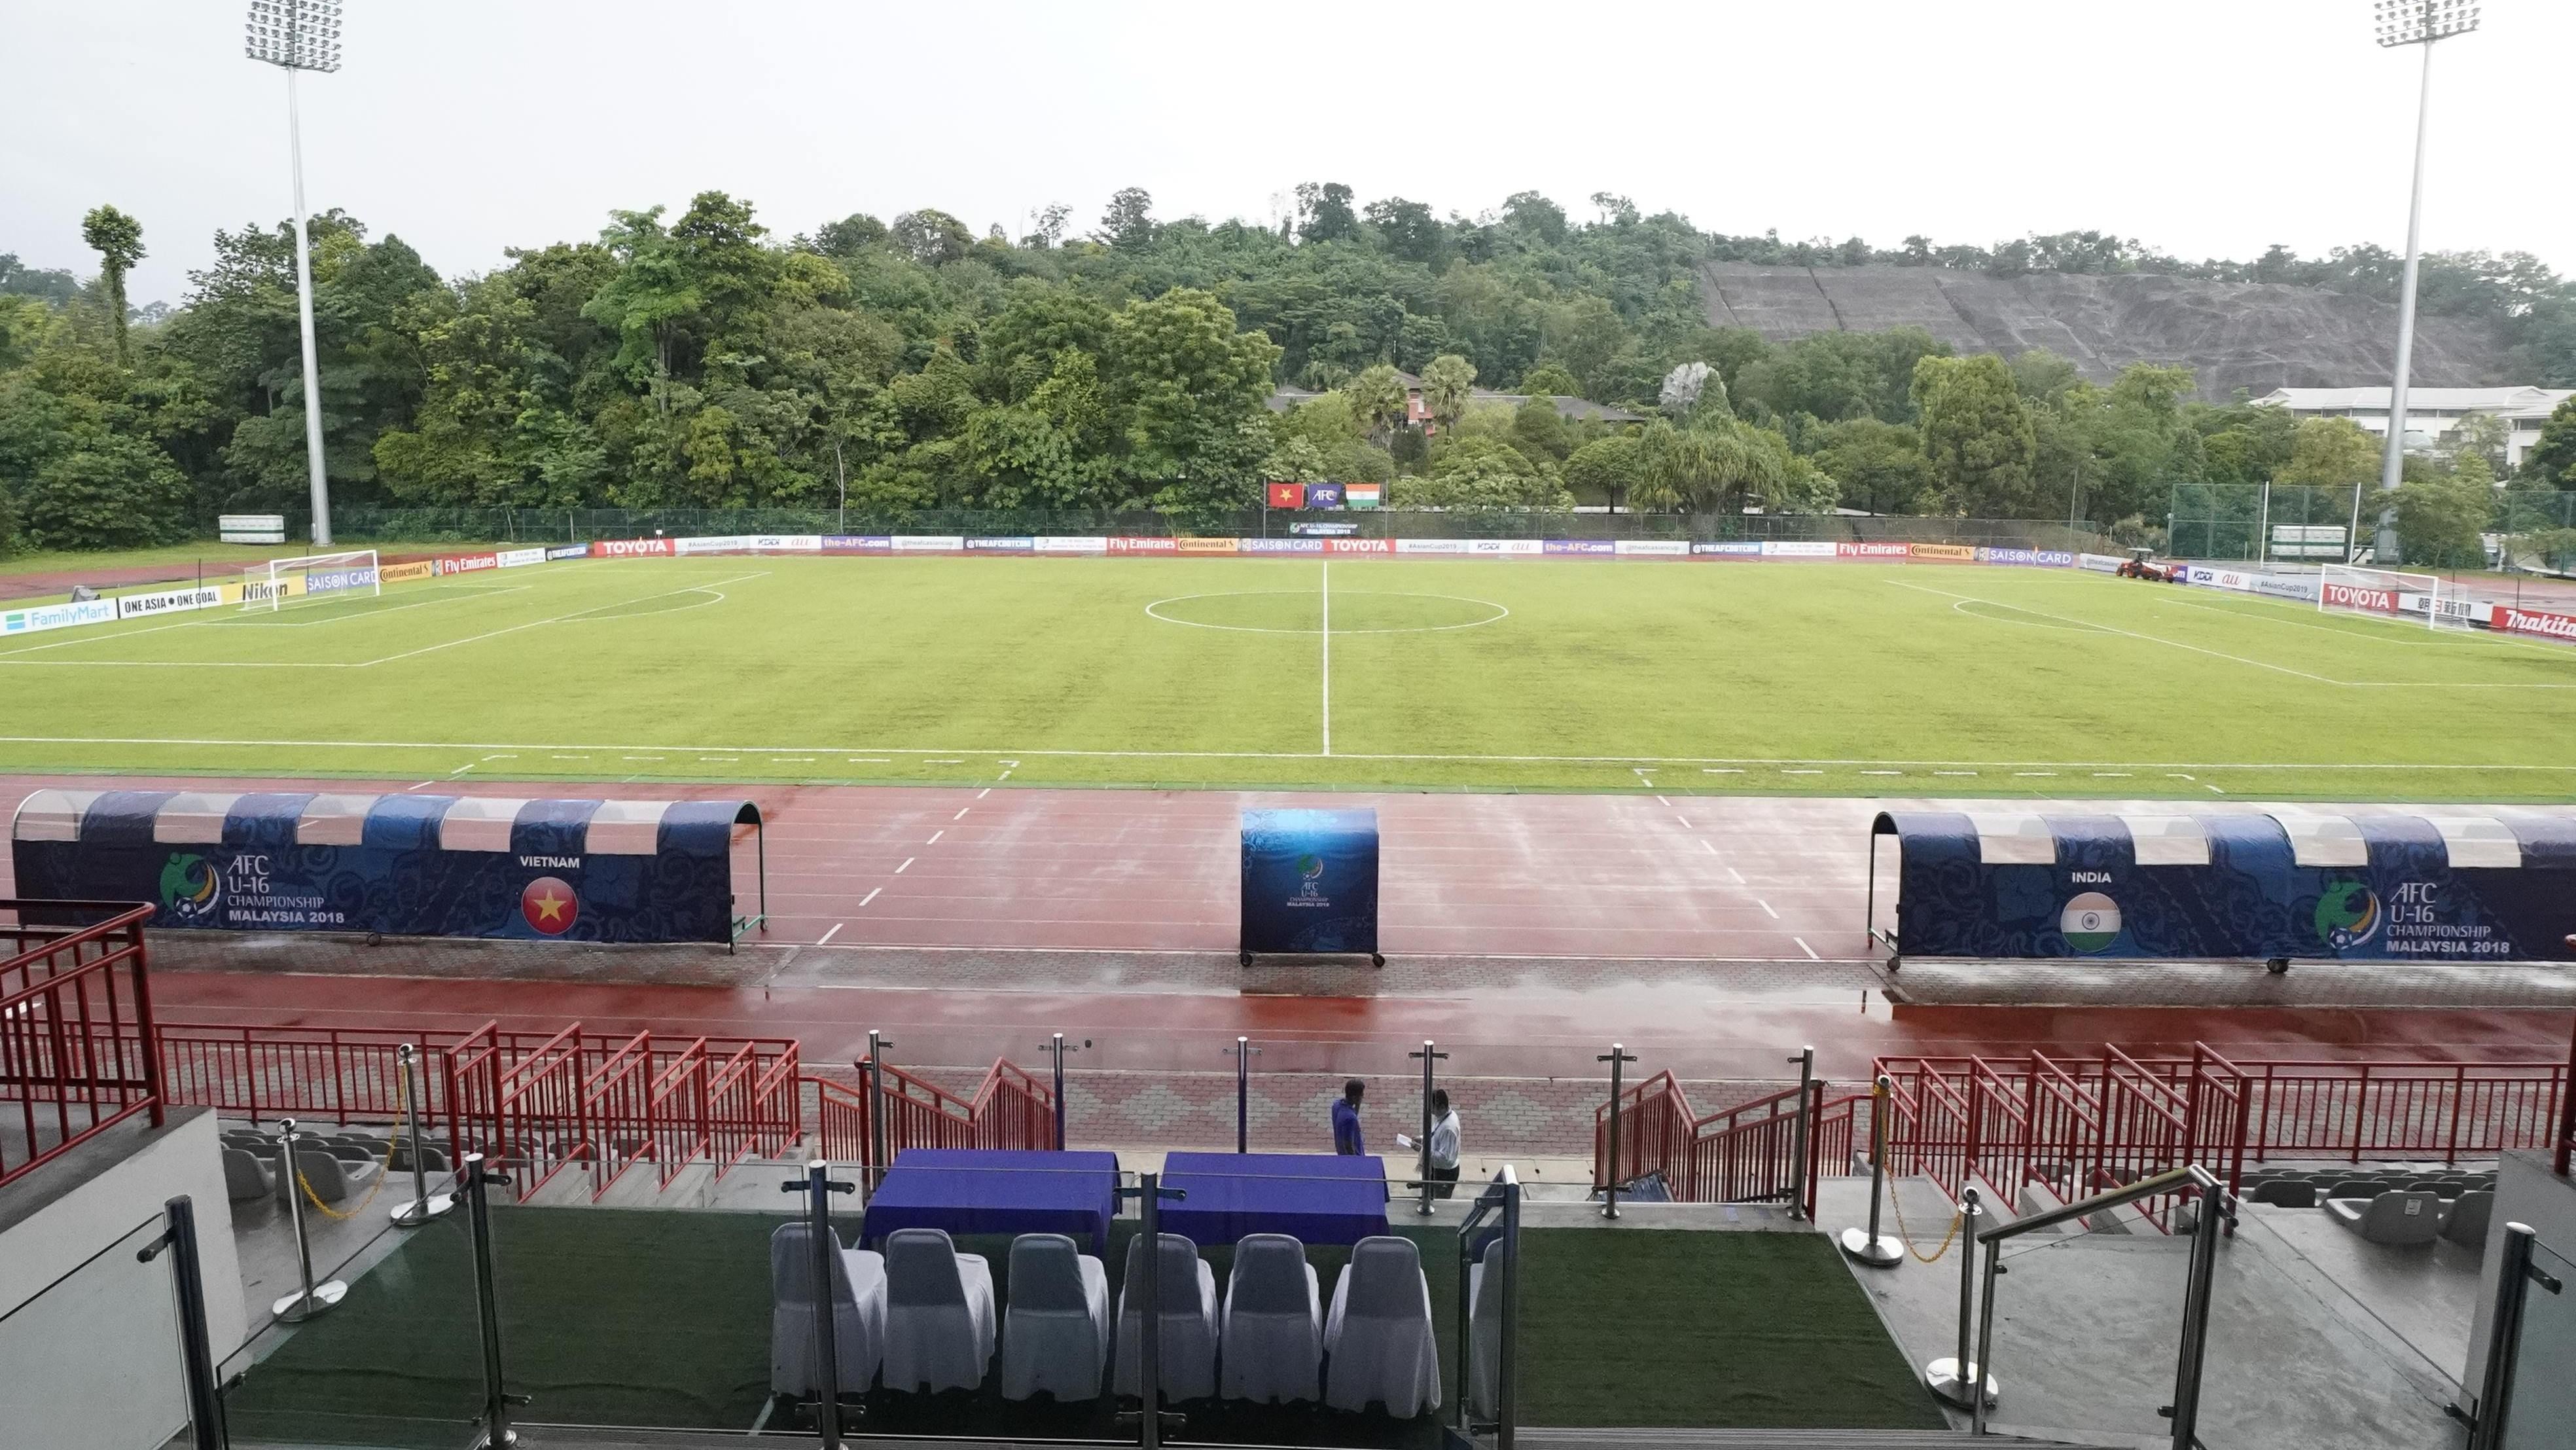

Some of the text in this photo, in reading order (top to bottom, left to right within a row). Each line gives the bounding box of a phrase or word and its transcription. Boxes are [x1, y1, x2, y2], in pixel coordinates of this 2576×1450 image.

[1312, 490, 1334, 501] AFC
[603, 539, 668, 554] TOYOTA
[824, 537, 889, 547] the-AFC.com
[1109, 537, 1175, 551] Fly Emirates
[1179, 539, 1226, 550] Continental
[1252, 540, 1322, 551] SAISON CARD
[1331, 539, 1389, 551] TOYOTA
[1545, 543, 1613, 552] the-AFC.com
[1840, 543, 1907, 556] Fly Emirates
[1911, 545, 1961, 556] Continental
[1990, 550, 2071, 564] SAISON CARD
[445, 556, 495, 574] Fly Emirates
[308, 570, 376, 591] SAISON CARD
[380, 565, 423, 582] Continental
[2194, 570, 2213, 582] KDDI
[2261, 580, 2308, 594] #AsianCup2019
[124, 590, 217, 613] ONE ASIA ONE GOAL
[2329, 585, 2389, 609] TOYOTA
[31, 603, 109, 628] FamilyMart
[227, 855, 269, 875] AFC
[520, 856, 580, 869] VIETNAM
[2072, 871, 2112, 884] INDIA
[228, 876, 270, 894] U-16
[1301, 882, 1319, 890] AFC
[2389, 883, 2437, 903] AFC
[227, 896, 325, 909] CHAMPIONSHIP
[229, 910, 345, 924] MALAYSIA 2018
[2391, 905, 2435, 923] U-16
[2387, 924, 2491, 938] CHAMPIONSHIP
[2386, 940, 2510, 954] MALAYSIA 2018
